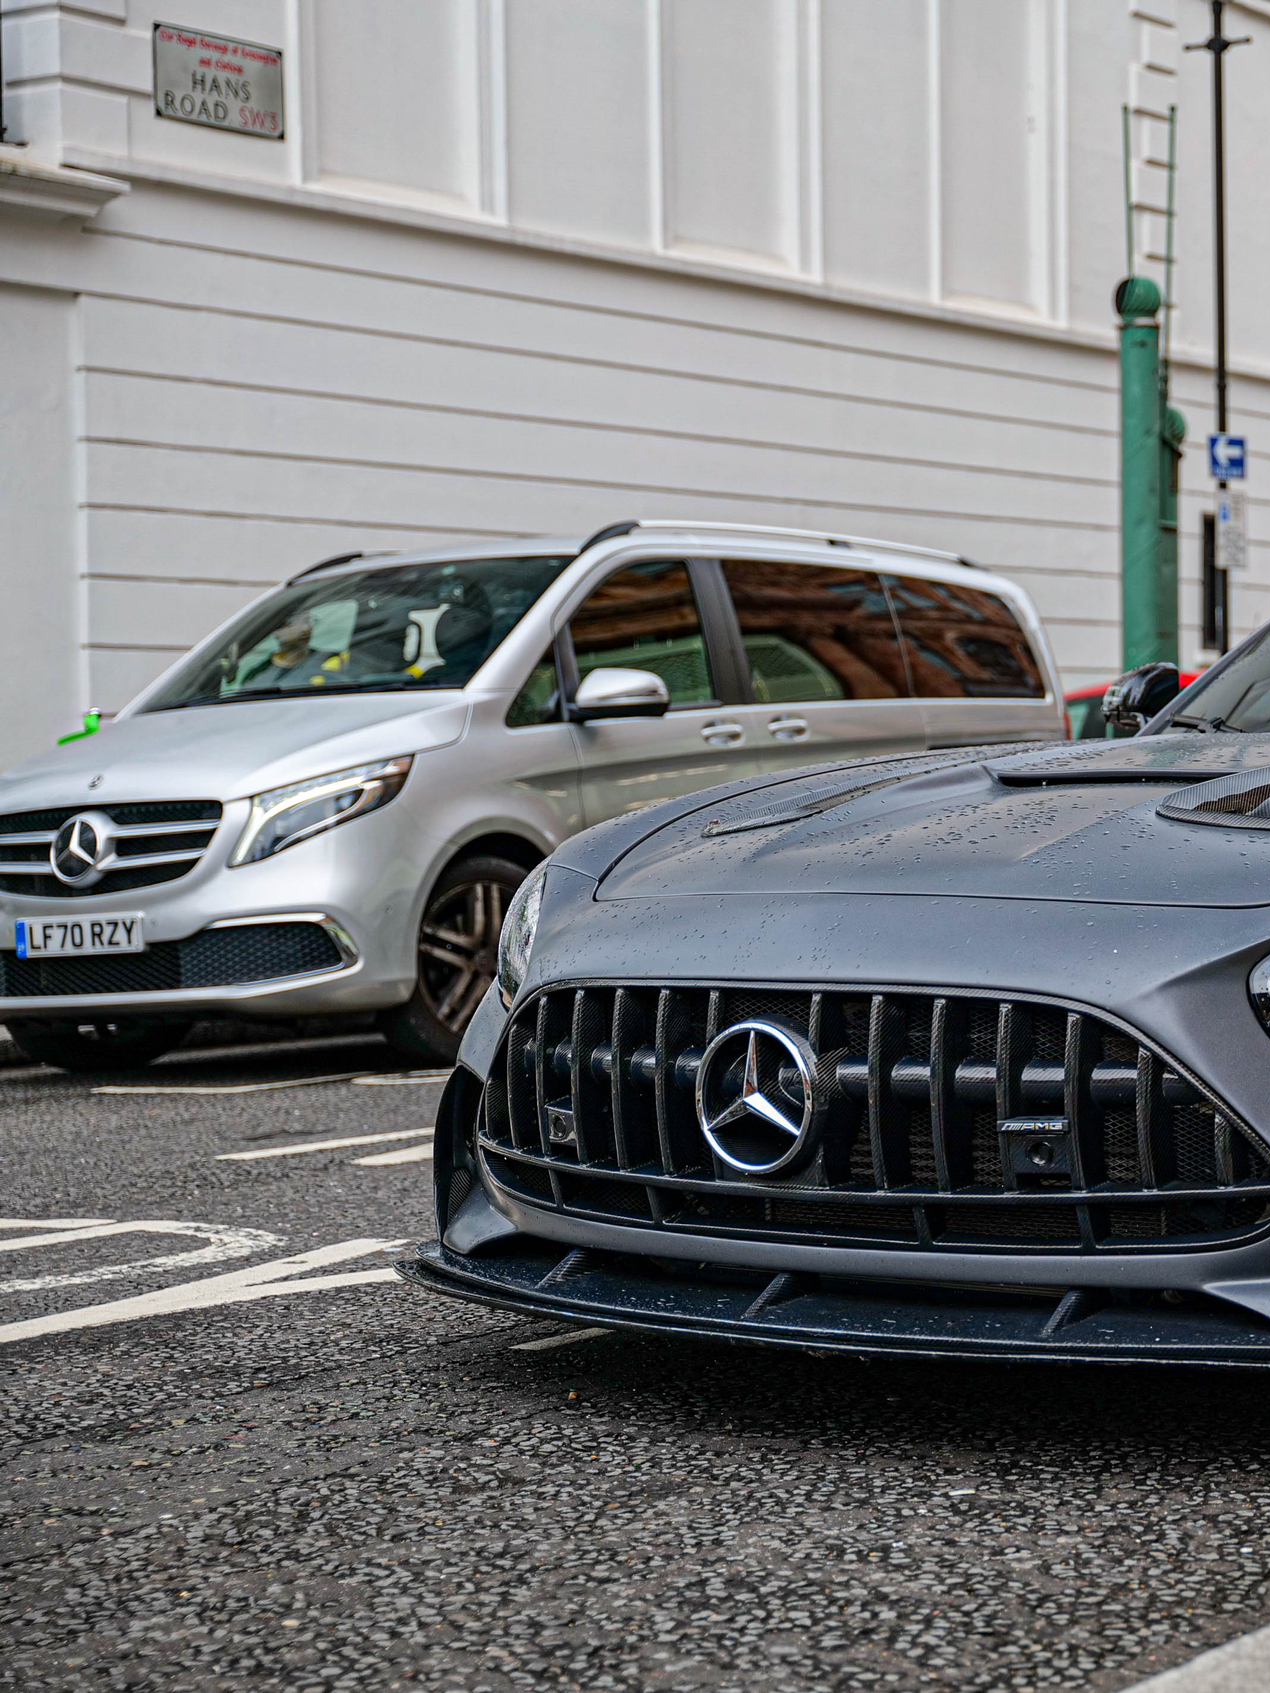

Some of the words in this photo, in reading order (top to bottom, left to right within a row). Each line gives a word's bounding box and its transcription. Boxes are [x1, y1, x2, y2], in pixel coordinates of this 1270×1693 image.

[191, 71, 252, 103] HANS
[164, 90, 228, 122] ROAD
[239, 105, 279, 133] SW3
[29, 923, 84, 950] LF70
[90, 920, 136, 947] RZY
[1021, 1122, 1063, 1131] AMG
